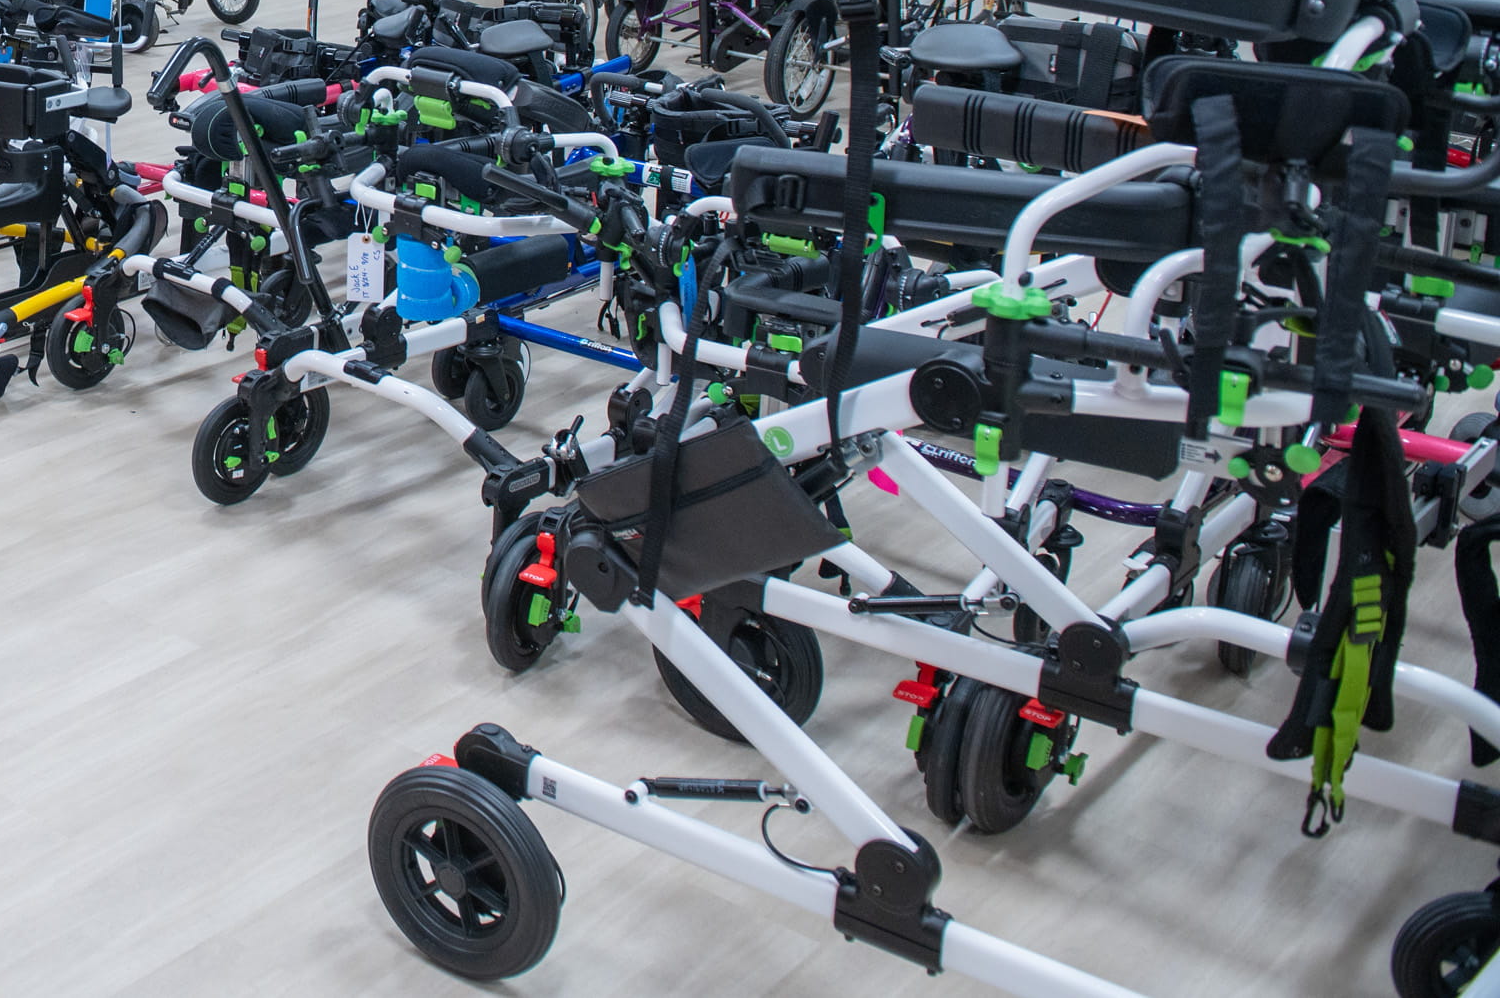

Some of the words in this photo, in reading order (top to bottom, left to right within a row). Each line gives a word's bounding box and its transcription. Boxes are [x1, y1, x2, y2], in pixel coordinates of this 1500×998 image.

[351, 274, 360, 293] Jack
[523, 572, 546, 582] STOP
[1023, 709, 1052, 722] STOP
